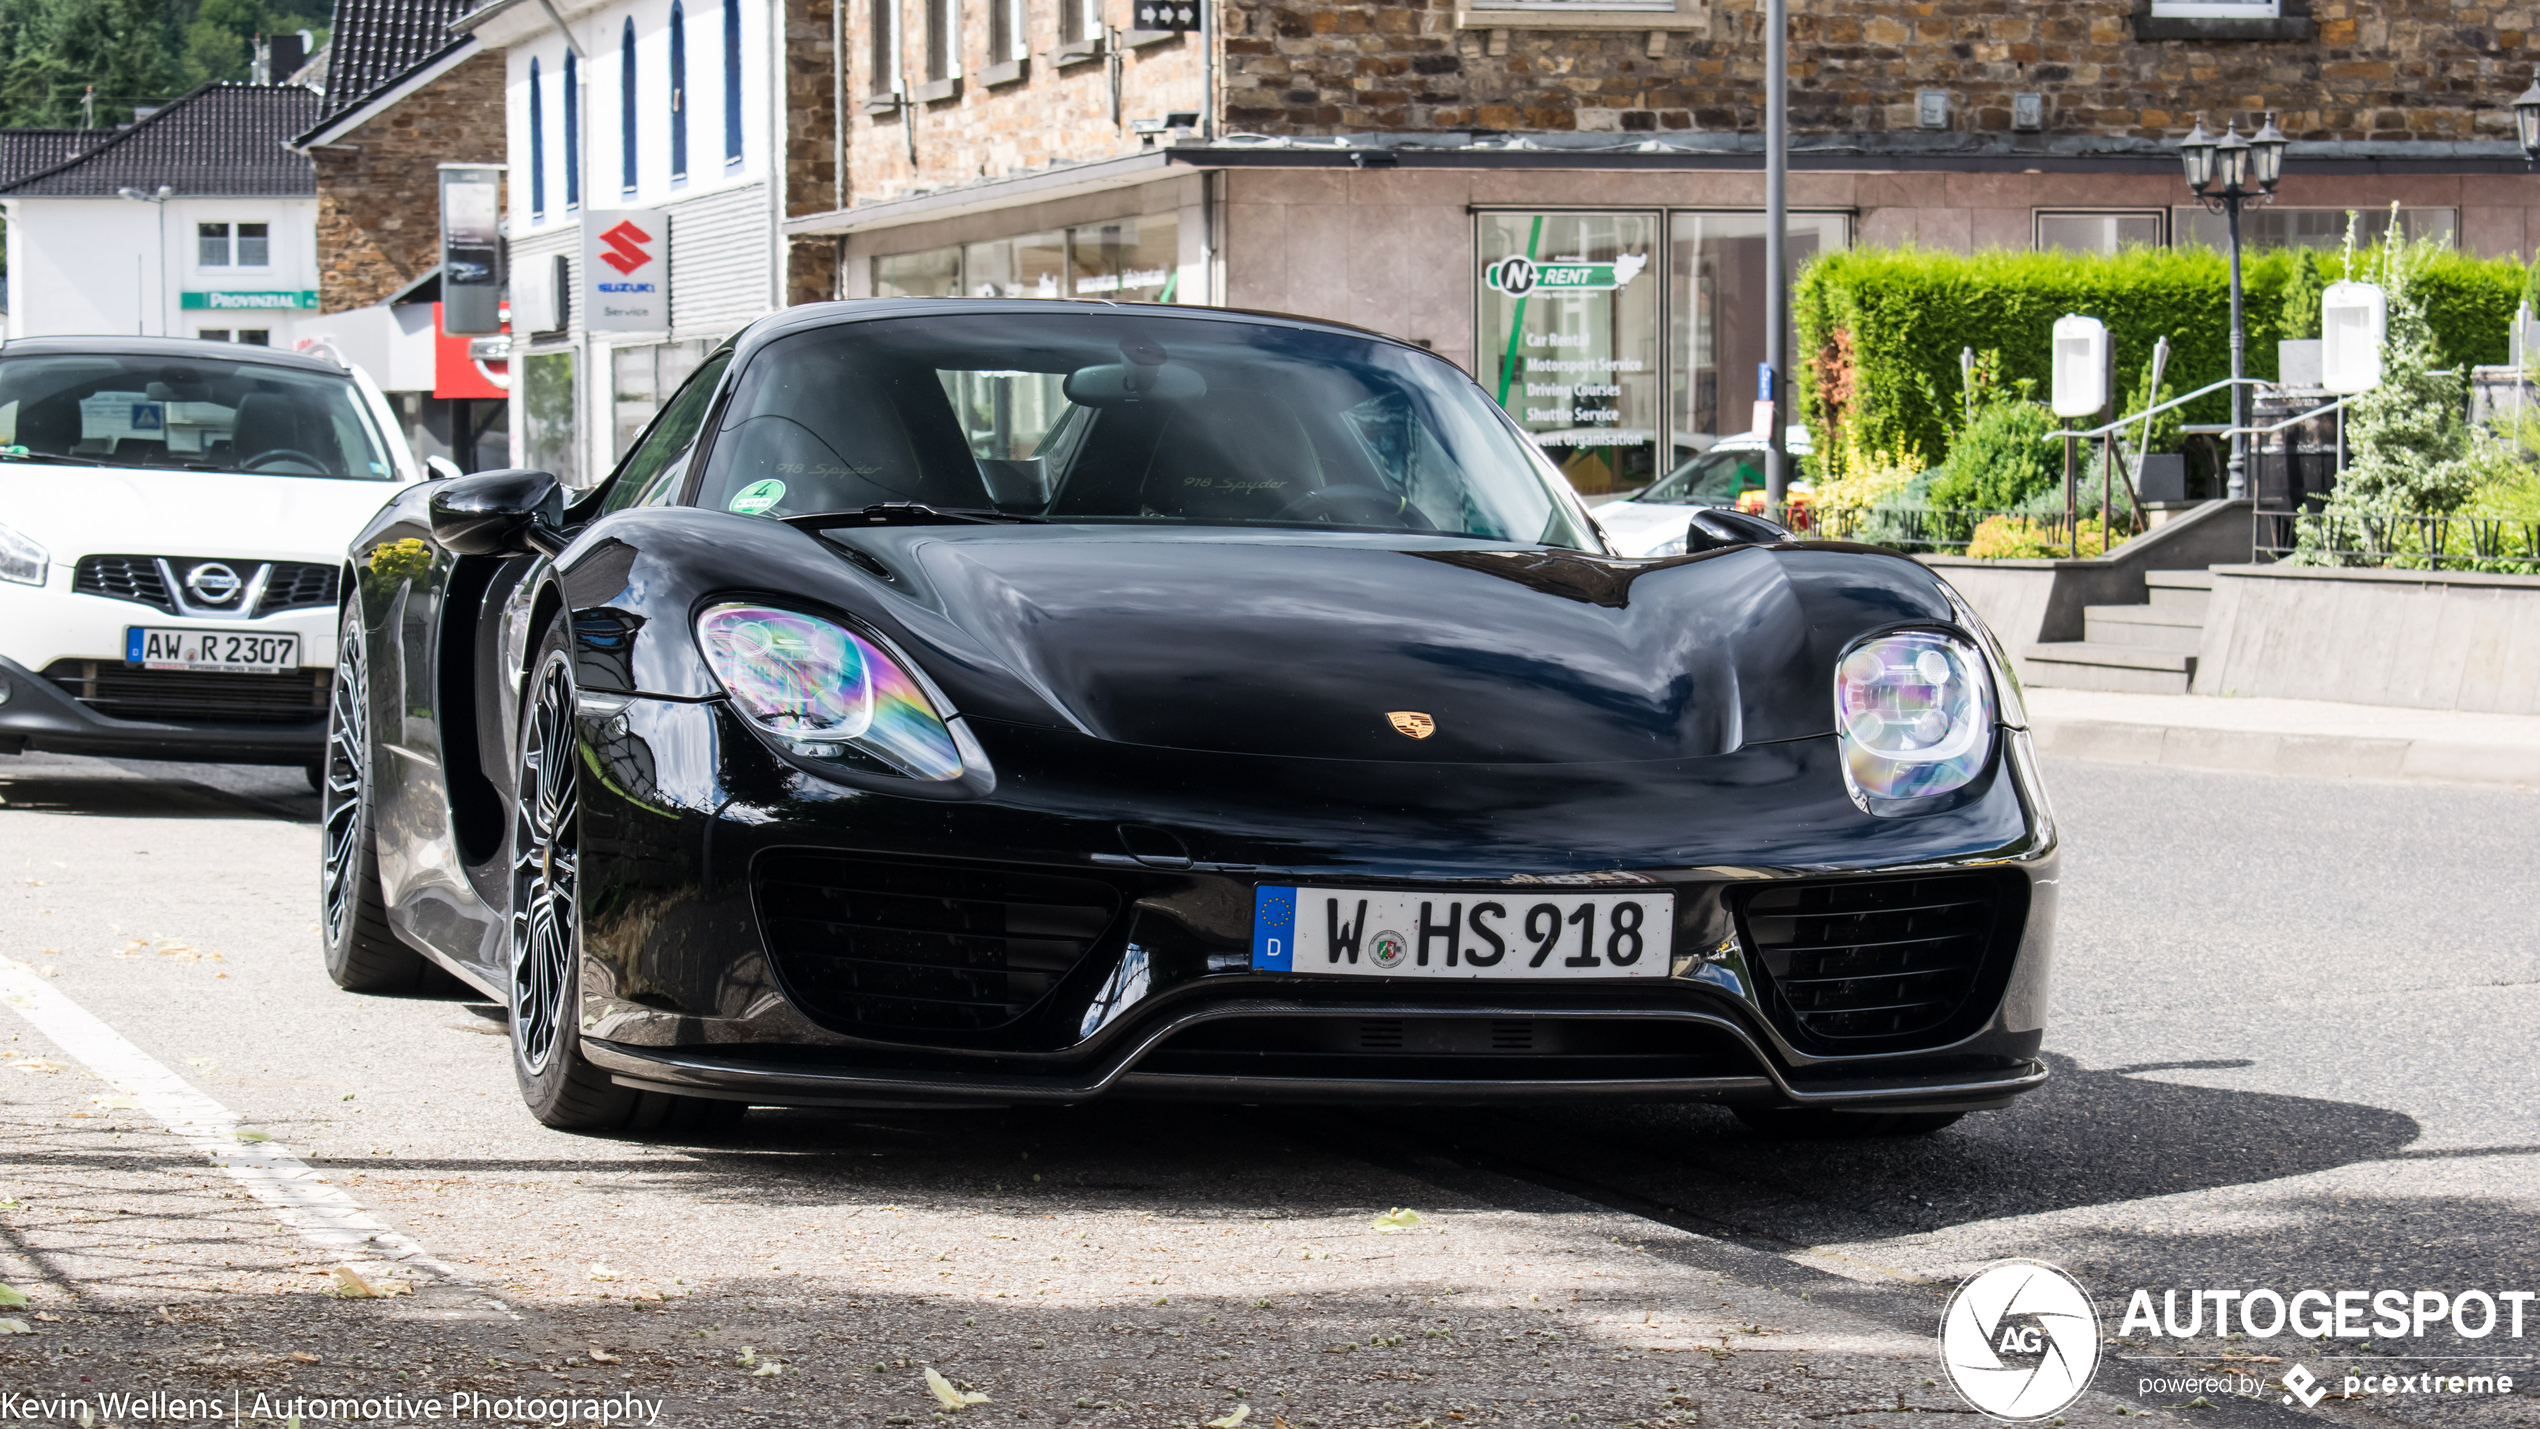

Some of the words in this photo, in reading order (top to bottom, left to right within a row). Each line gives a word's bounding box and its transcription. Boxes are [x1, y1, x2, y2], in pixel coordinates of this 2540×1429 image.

[597, 282, 656, 294] SUZUKI
[209, 292, 297, 308] PROVINZIAL
[603, 305, 650, 318] Service
[1526, 332, 1548, 348] Car
[1548, 332, 1591, 347] Rental
[1526, 357, 1596, 375] Motorsport
[1598, 356, 1643, 372] Service
[1526, 382, 1573, 399] Driving
[1573, 382, 1622, 397] Courses
[1526, 407, 1574, 421] Shuttle
[1574, 406, 1620, 421] Service
[1563, 431, 1644, 449] Organisation
[775, 463, 805, 474] 918
[807, 463, 883, 479] Spyder
[753, 482, 773, 499] 4
[1183, 477, 1213, 488] 918
[1215, 478, 1289, 493] Spyder
[145, 633, 182, 660] AW
[201, 635, 218, 662] R
[225, 636, 294, 665] 2307
[1267, 938, 1281, 957] D
[1326, 897, 1368, 965] W
[1416, 901, 1507, 968] HS
[1525, 900, 1645, 968] 918
